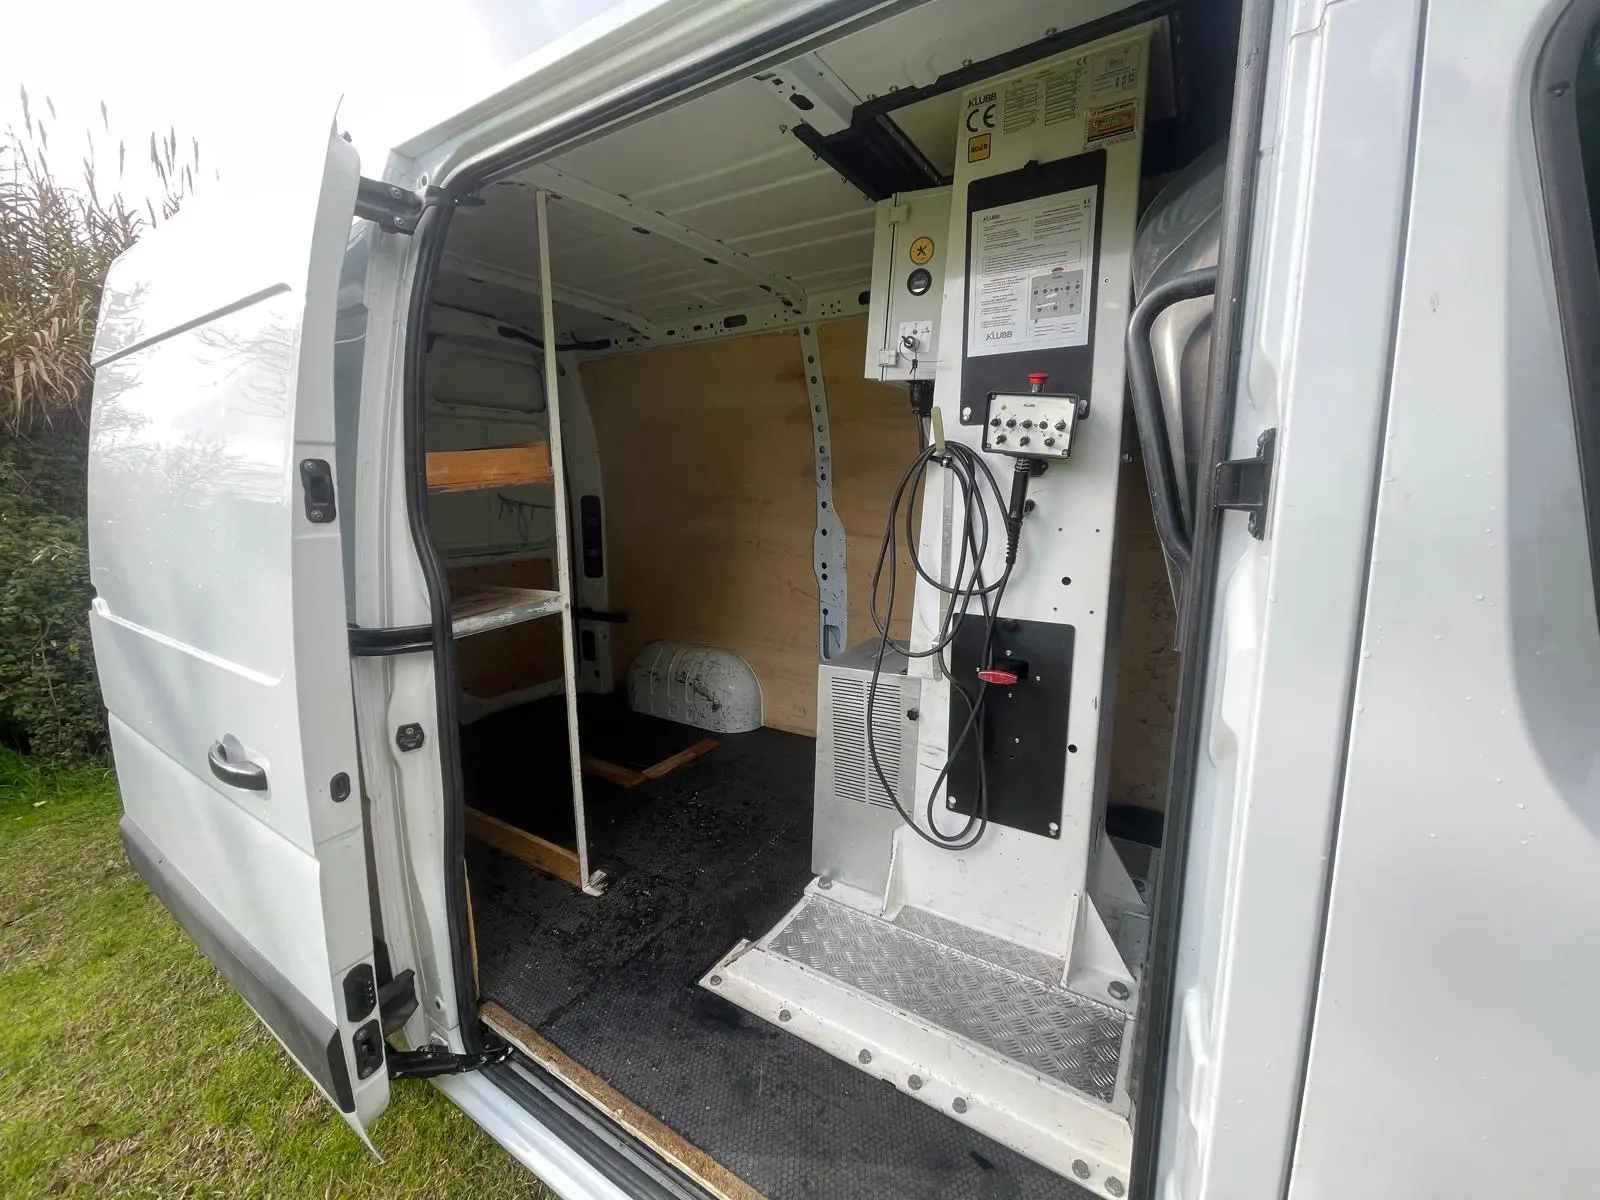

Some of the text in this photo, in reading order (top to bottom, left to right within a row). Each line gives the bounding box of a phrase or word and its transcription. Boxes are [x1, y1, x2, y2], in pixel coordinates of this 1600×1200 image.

[967, 92, 997, 108] KLUBB
[966, 104, 996, 132] CE
[985, 330, 1013, 341] KLUBB
